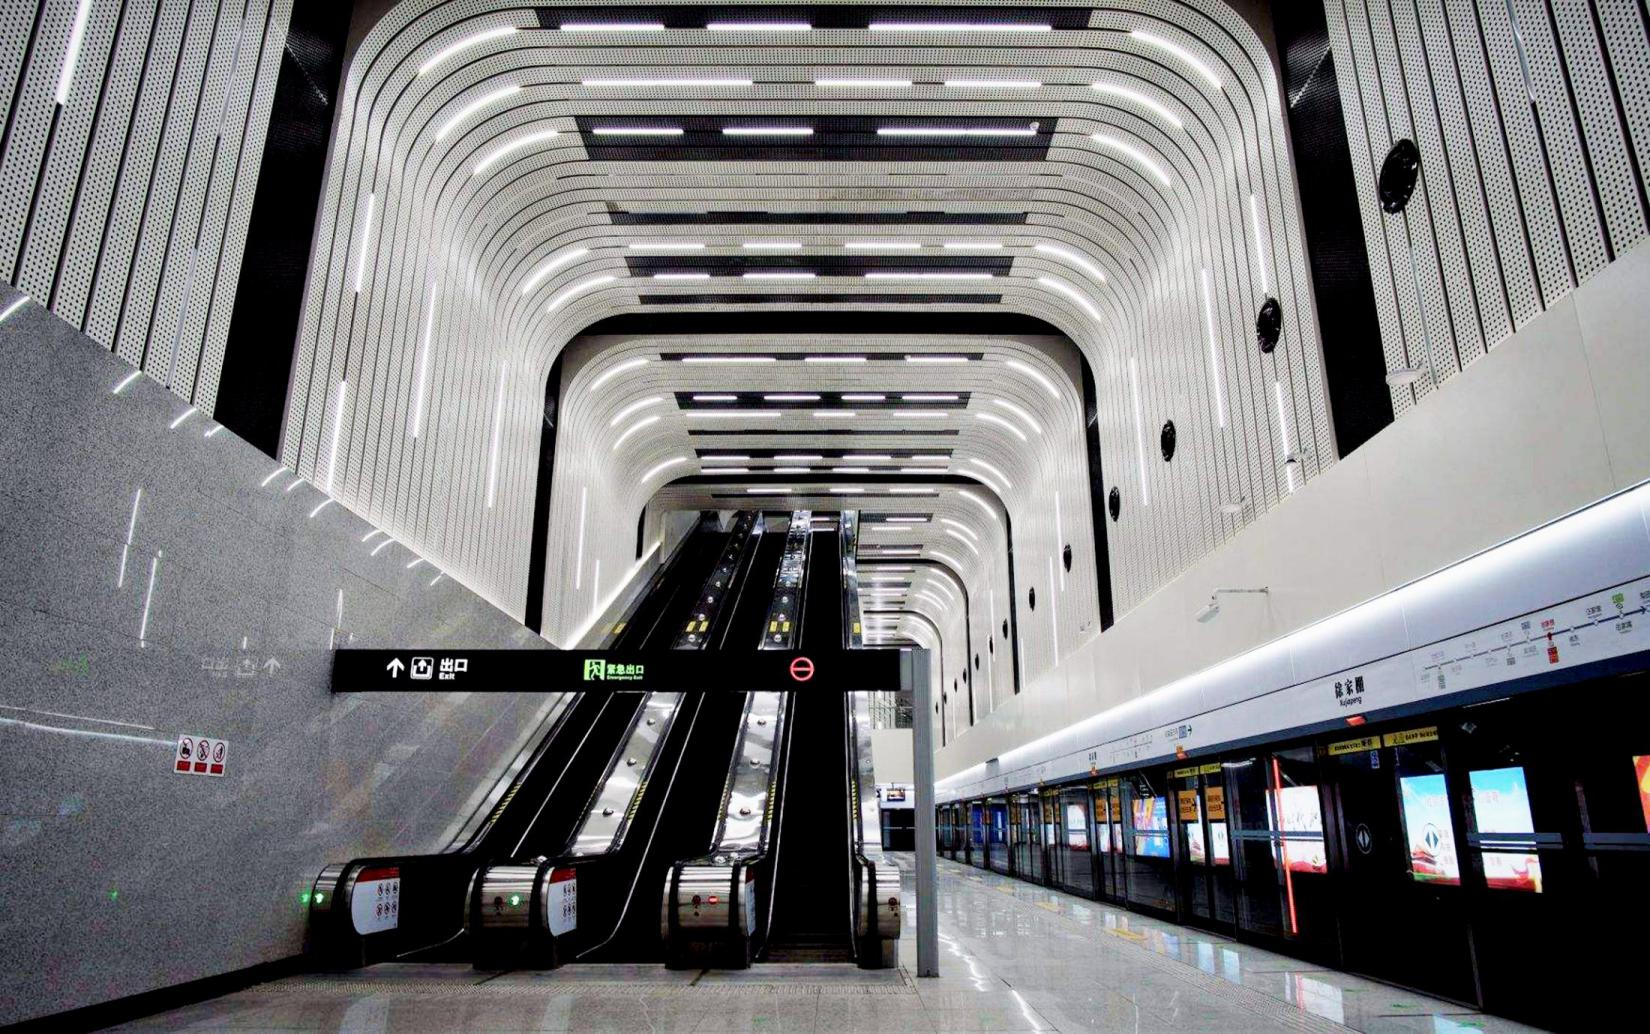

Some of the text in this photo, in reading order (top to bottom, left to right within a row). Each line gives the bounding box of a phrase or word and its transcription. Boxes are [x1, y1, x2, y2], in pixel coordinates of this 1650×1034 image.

[439, 657, 468, 672] 出口
[606, 663, 644, 675] 紧急出口
[439, 672, 455, 680] Exit
